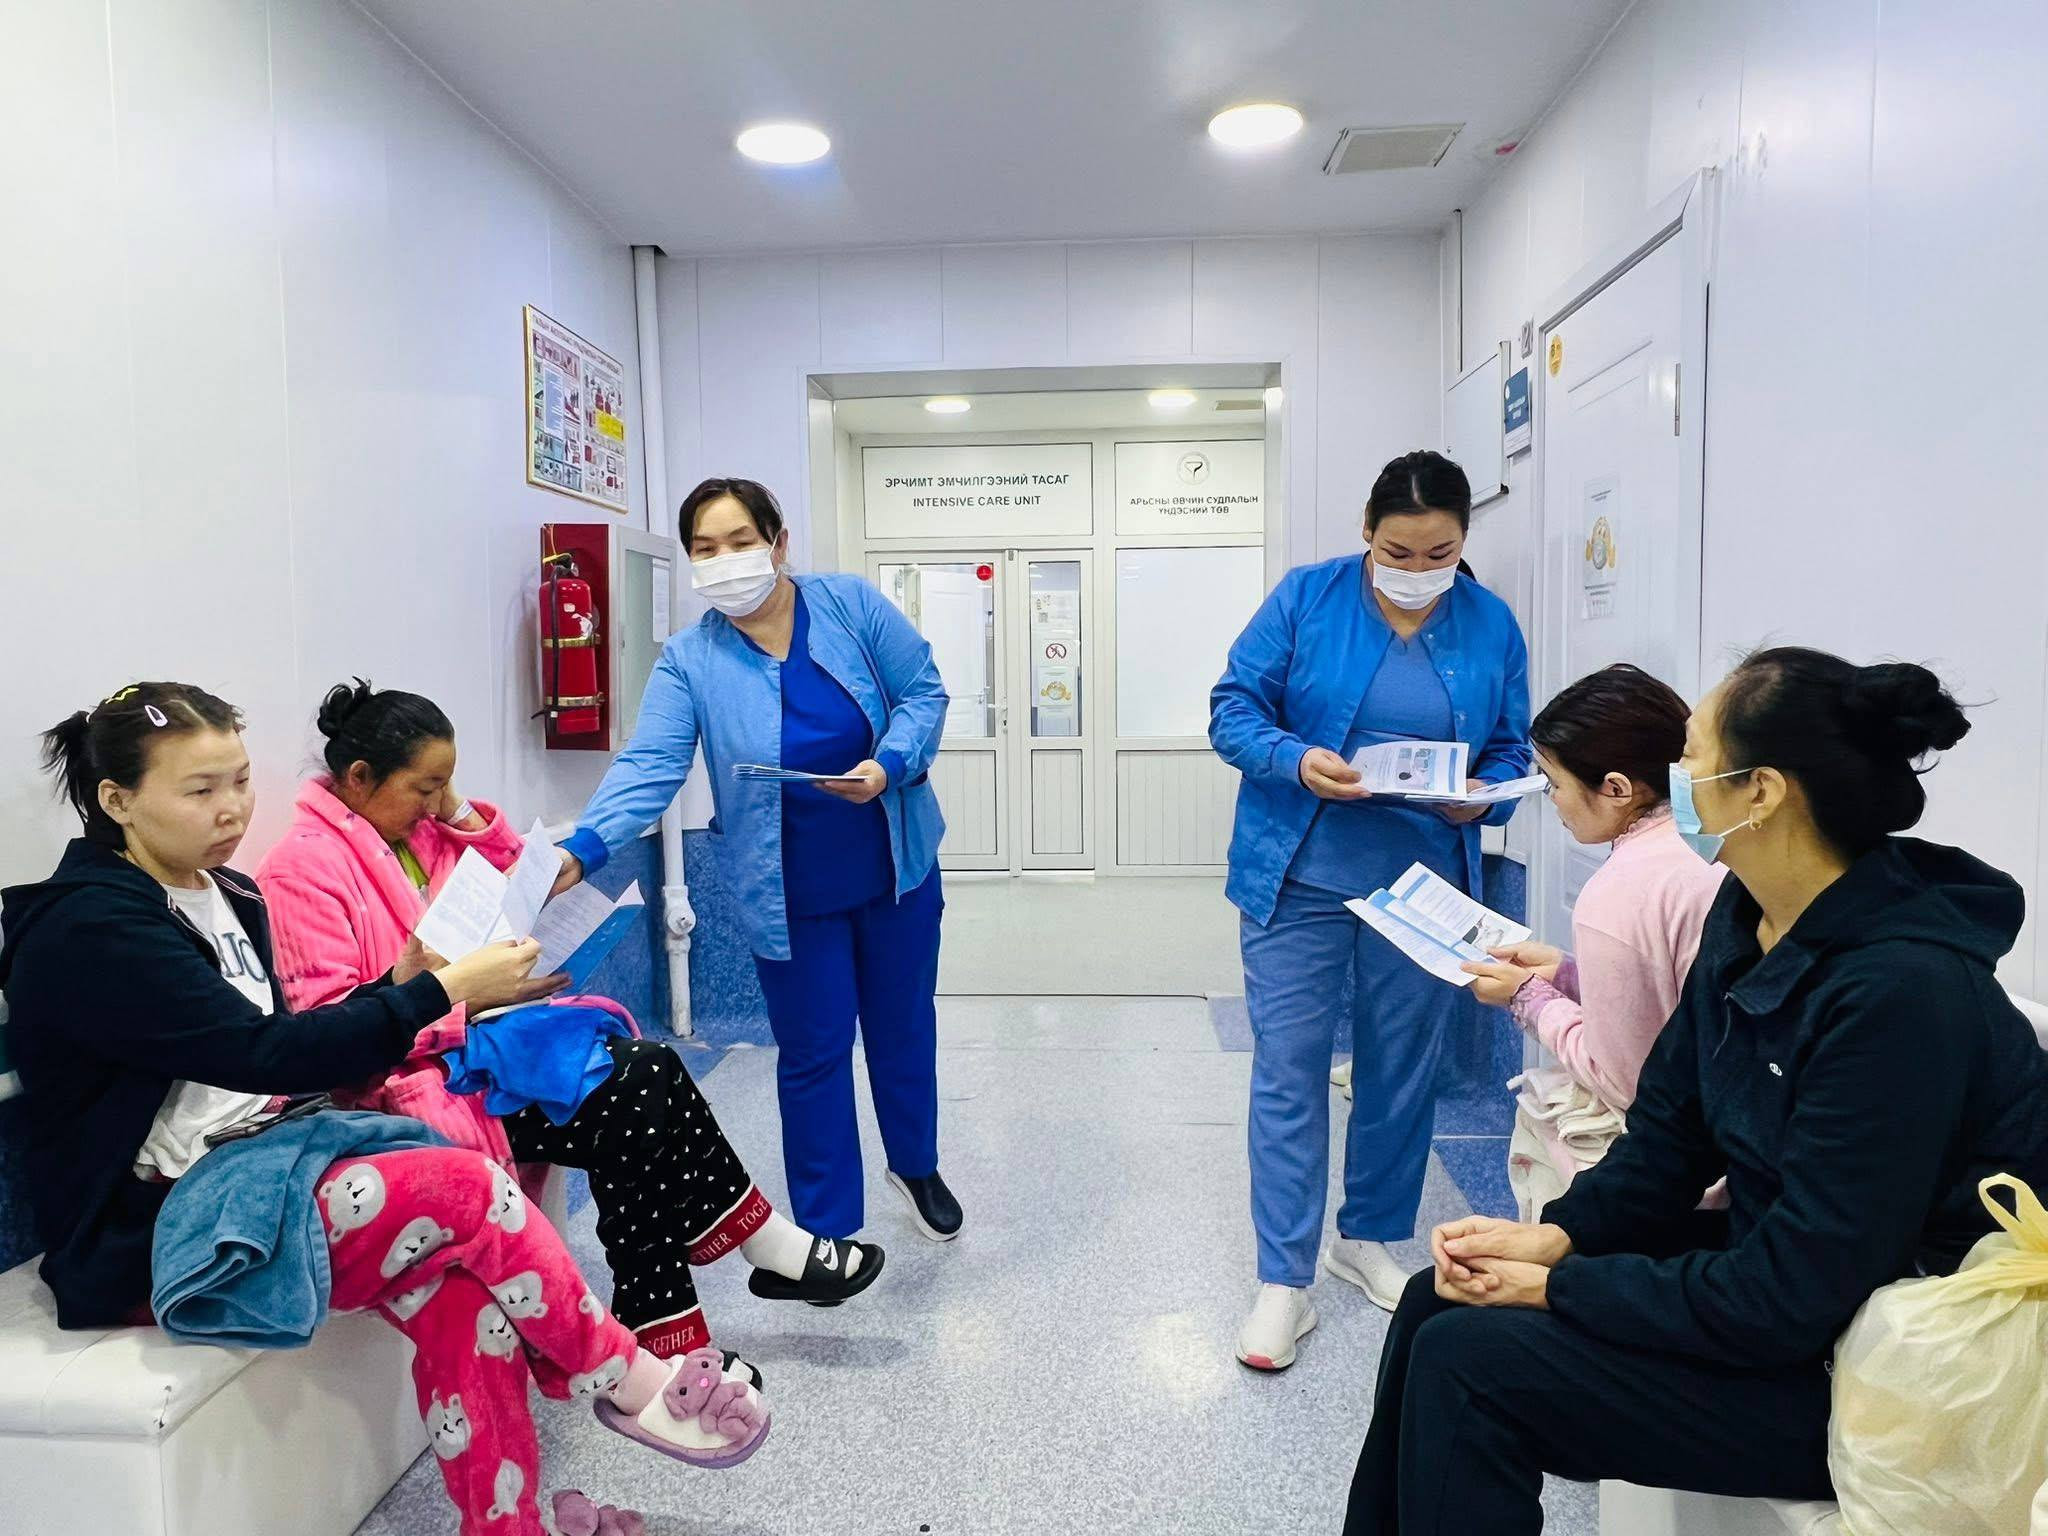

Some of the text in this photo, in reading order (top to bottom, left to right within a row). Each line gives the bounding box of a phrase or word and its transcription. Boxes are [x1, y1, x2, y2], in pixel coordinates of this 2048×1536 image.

[885, 474, 1070, 488] ЭРЧИМТ ЭМЧИЛГЭЭНИЙ ТАСАГ
[913, 495, 1041, 507] INTENSIVE CARE UNIT
